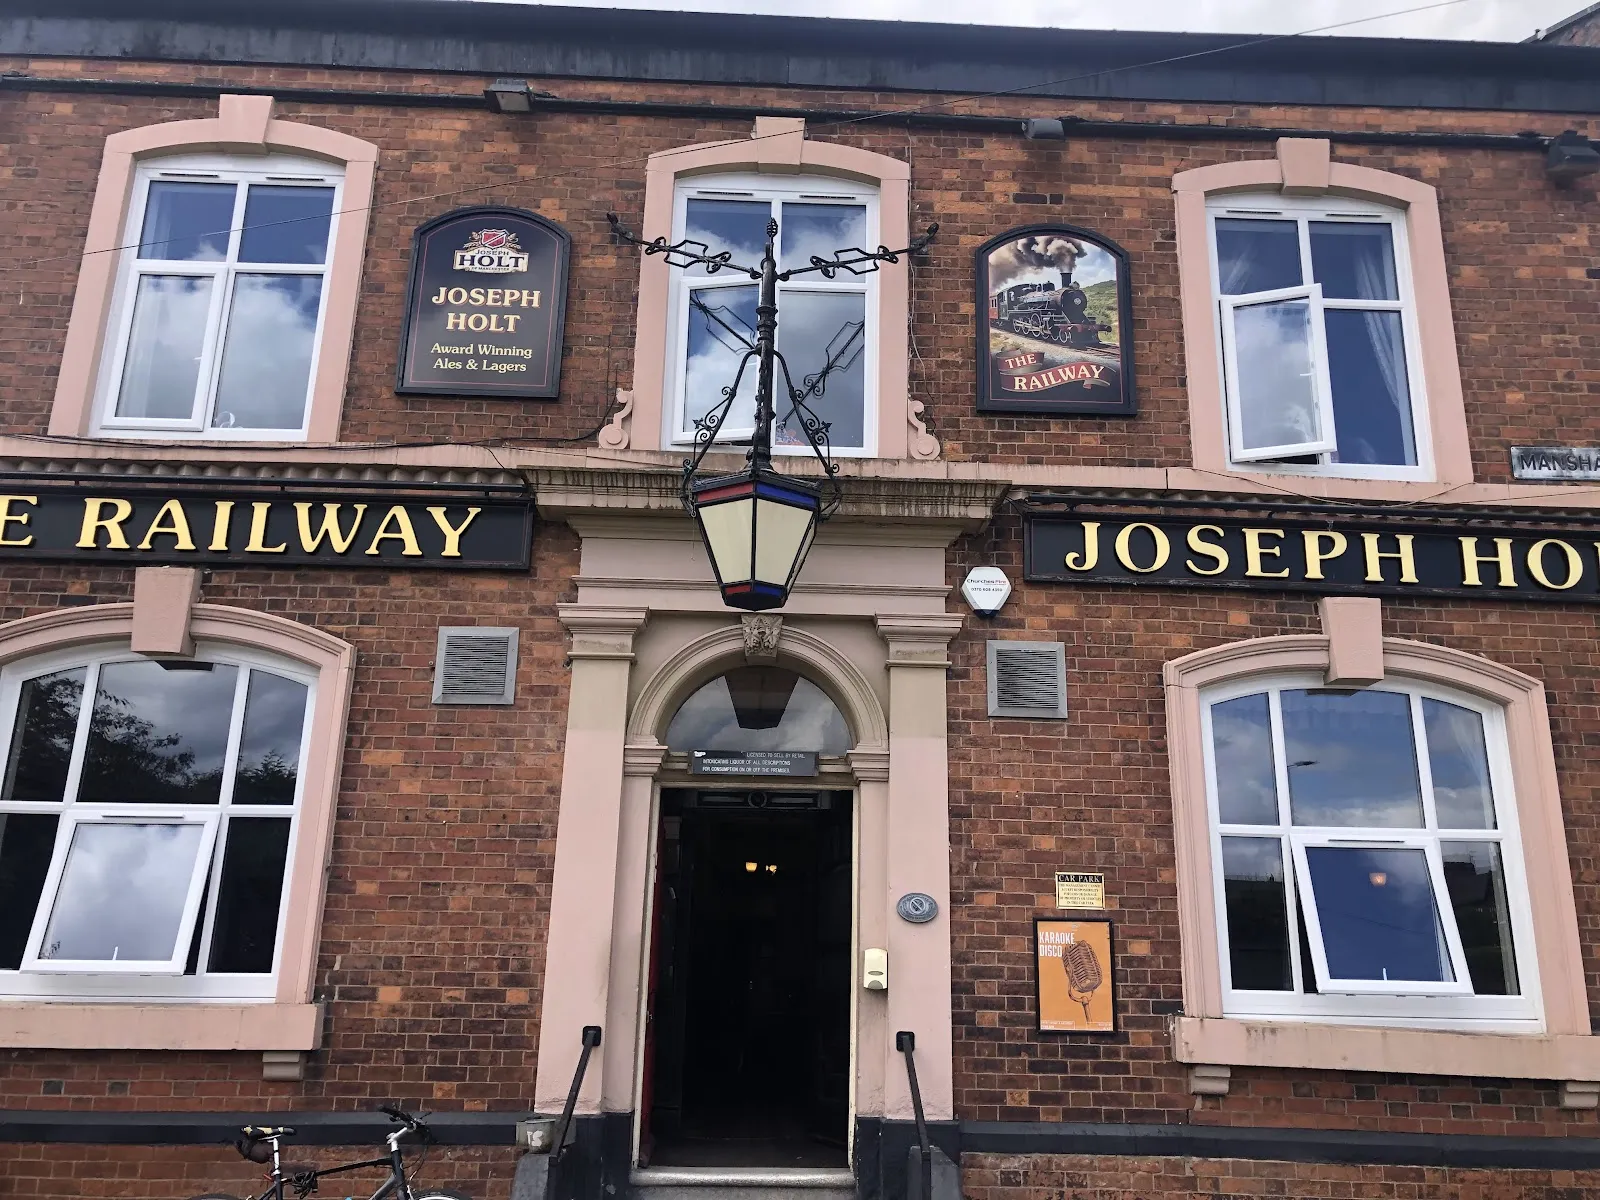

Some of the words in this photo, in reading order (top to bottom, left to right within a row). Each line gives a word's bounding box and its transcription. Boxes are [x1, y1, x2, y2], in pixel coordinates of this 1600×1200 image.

[459, 254, 524, 268] HOLT
[432, 287, 540, 308] JOSEPH
[446, 312, 521, 333] HOLT
[431, 342, 474, 356] Award
[477, 344, 533, 359] Winning
[433, 358, 463, 370] Ales
[466, 359, 479, 371] &
[482, 359, 527, 373] Lagers
[1005, 354, 1036, 368] THE
[1014, 364, 1104, 390] RAILWAY
[75, 497, 482, 557] RAILWAY
[1064, 522, 1419, 583] JOSEPH
[1458, 536, 1600, 590] HO
[1040, 932, 1075, 944] KARAOKE
[1040, 945, 1062, 957] DISCO
